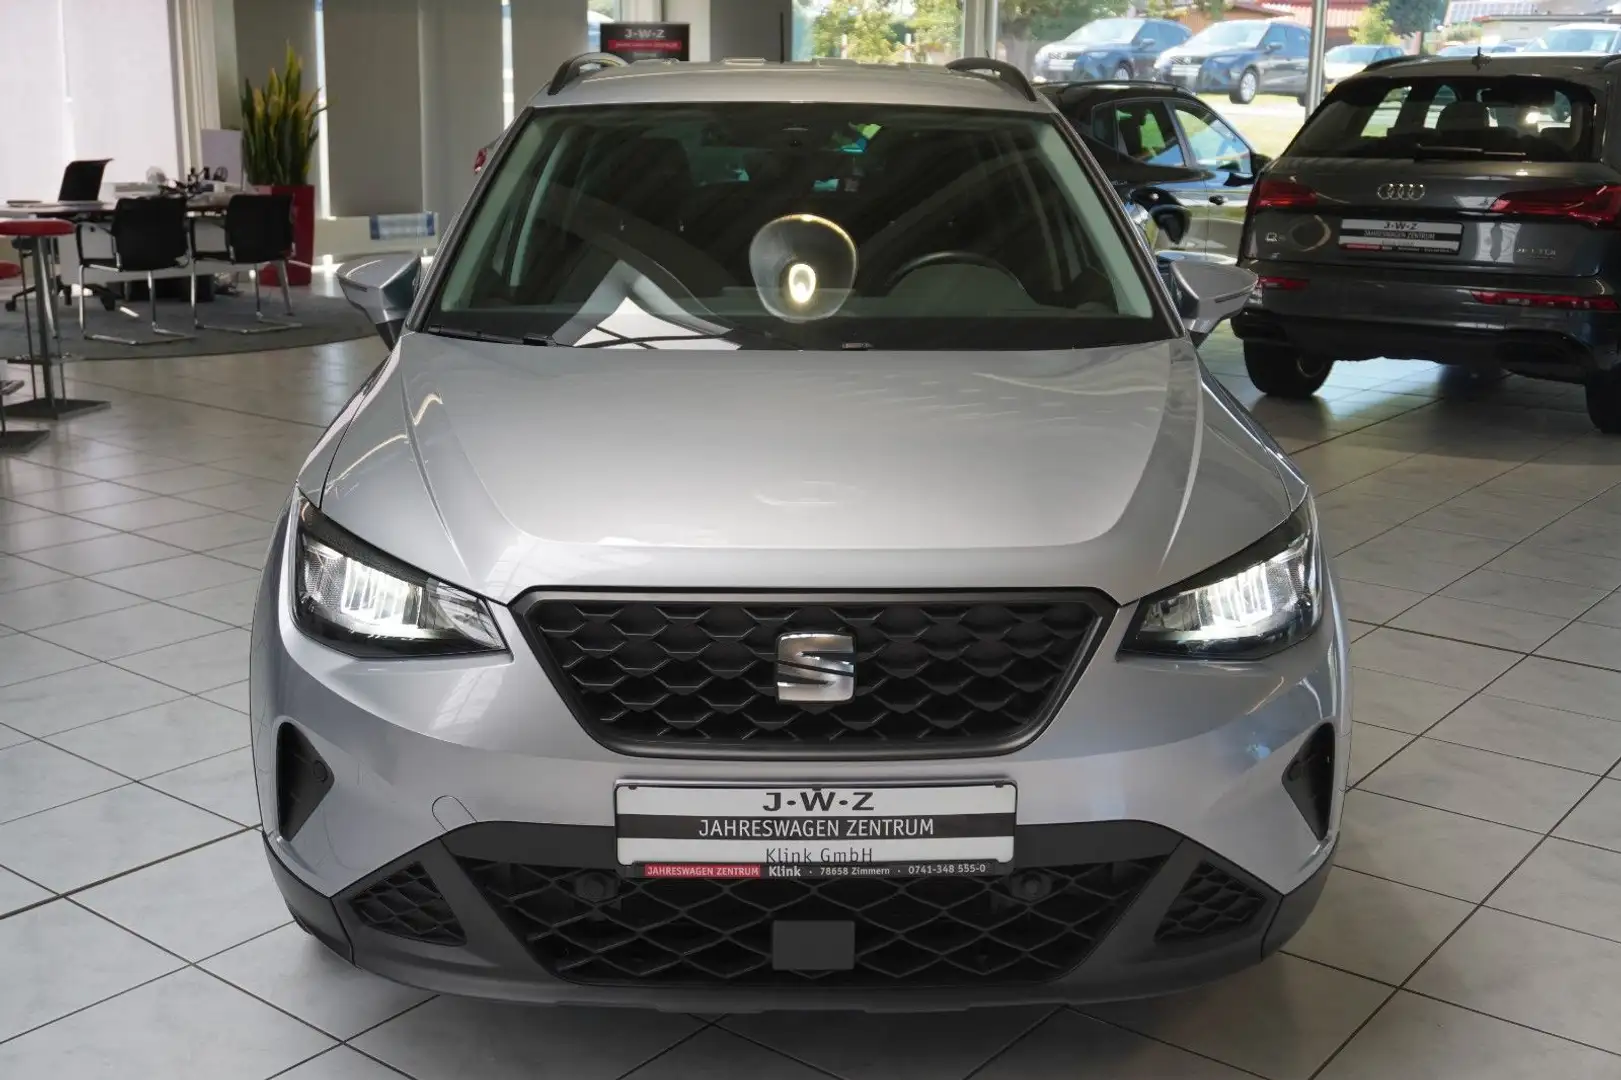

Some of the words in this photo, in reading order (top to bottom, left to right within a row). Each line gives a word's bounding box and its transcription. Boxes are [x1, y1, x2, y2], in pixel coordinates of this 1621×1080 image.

[699, 819, 839, 838] JAHRESWAGEN
[846, 818, 935, 837] ZENTRUM
[765, 848, 812, 864] Klink
[820, 847, 874, 863] GmbH
[647, 866, 714, 877] JAHRESWAGEN
[716, 866, 760, 877] ZENTRUM
[768, 864, 802, 878] Klink
[820, 866, 849, 877] 78658
[851, 865, 892, 877] Zimmern
